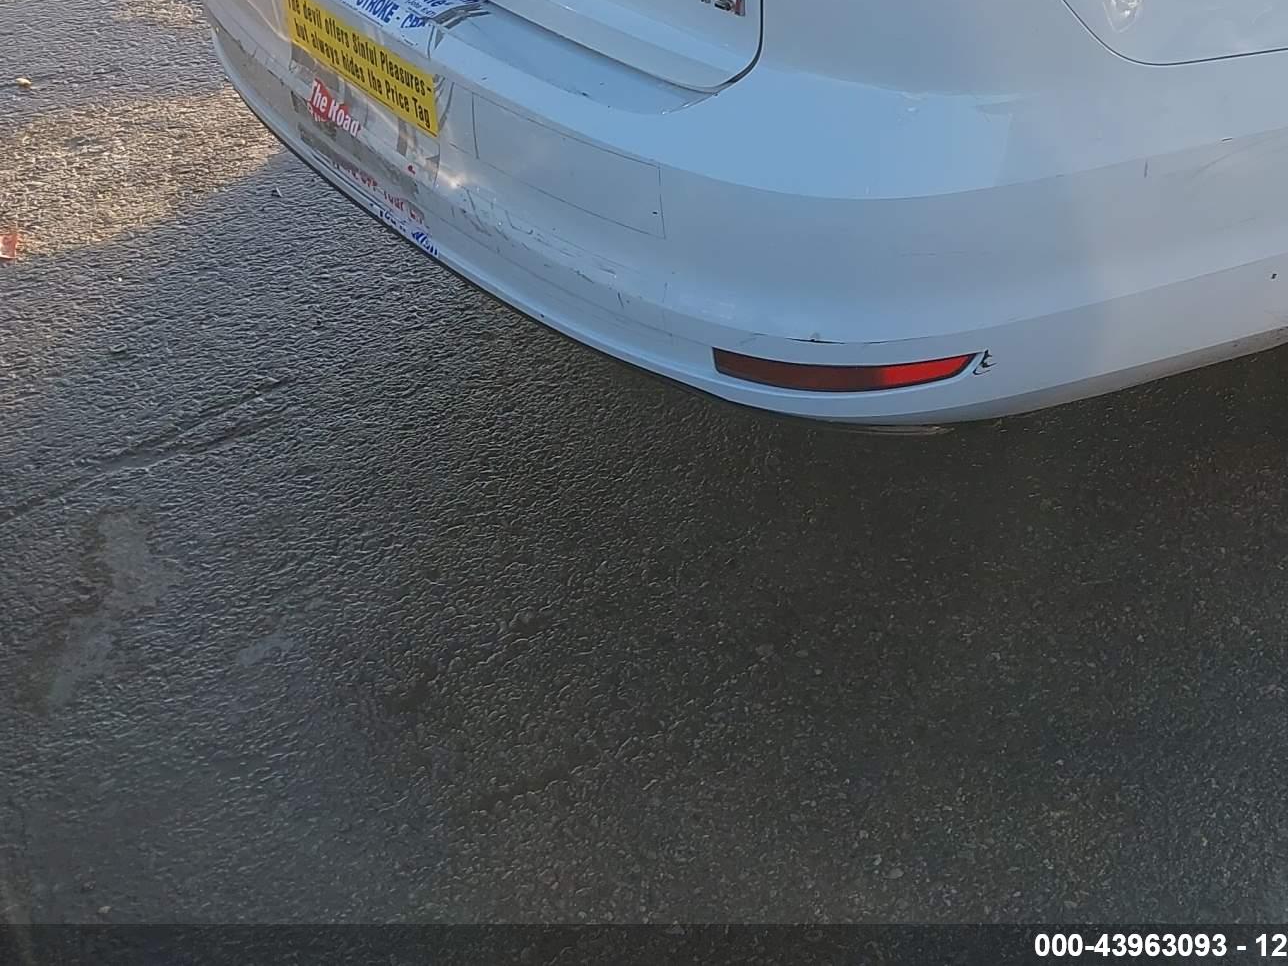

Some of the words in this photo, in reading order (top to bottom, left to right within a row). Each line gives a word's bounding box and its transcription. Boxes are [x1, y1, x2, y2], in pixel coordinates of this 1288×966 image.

[293, 18, 309, 43] but
[311, 32, 340, 65] always
[341, 50, 365, 83] hides
[367, 68, 383, 95] the
[385, 82, 410, 113] Price
[412, 97, 431, 129] Tag
[303, 0, 323, 30] devil
[325, 17, 350, 50] offers
[352, 33, 378, 67] Sinful
